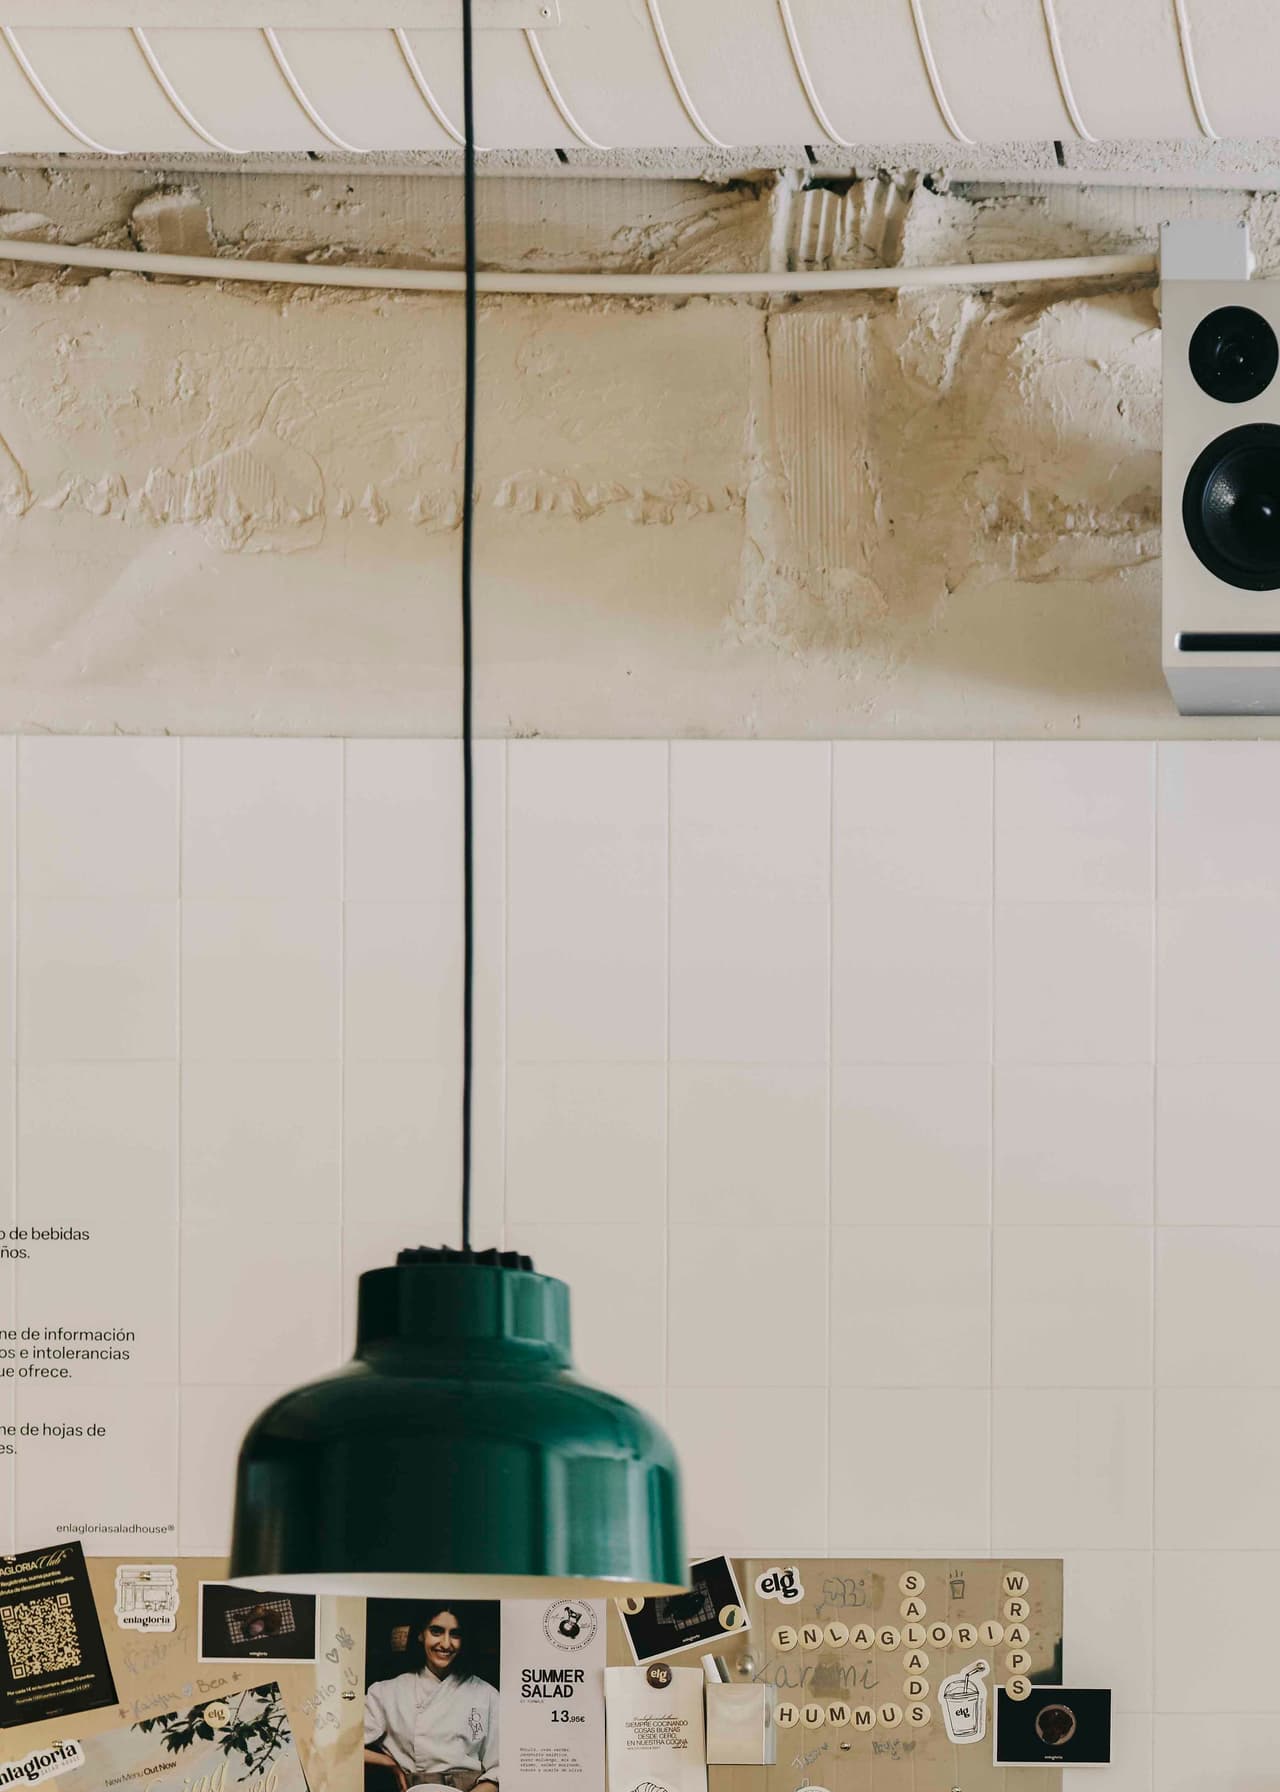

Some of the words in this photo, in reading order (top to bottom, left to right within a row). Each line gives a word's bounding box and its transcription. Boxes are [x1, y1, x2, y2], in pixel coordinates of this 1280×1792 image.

[10, 1228, 28, 1241] de
[31, 1228, 89, 1241] bebidas
[21, 1328, 40, 1341] de
[44, 1328, 135, 1342] información
[20, 1348, 29, 1359] e
[33, 1347, 130, 1360] intolerancias
[19, 1366, 72, 1378] ofrece.
[20, 1423, 39, 1436] de
[43, 1423, 83, 1440] hojas
[87, 1423, 106, 1437] de
[761, 1572, 799, 1598] elg
[123, 1614, 171, 1627] enlagloria
[778, 1627, 1024, 1646] ENLAGLORIA
[1006, 1575, 1025, 1694] WRAPS
[905, 1575, 924, 1723] SALADS
[521, 1669, 584, 1683] SUMMER
[650, 1669, 667, 1683] elg
[521, 1684, 574, 1698] SALAD
[208, 1708, 225, 1721] elg
[779, 1707, 923, 1727] HUMMUS
[955, 1708, 971, 1719] elg
[143, 1765, 159, 1776] Out
[158, 1760, 177, 1772] Now
